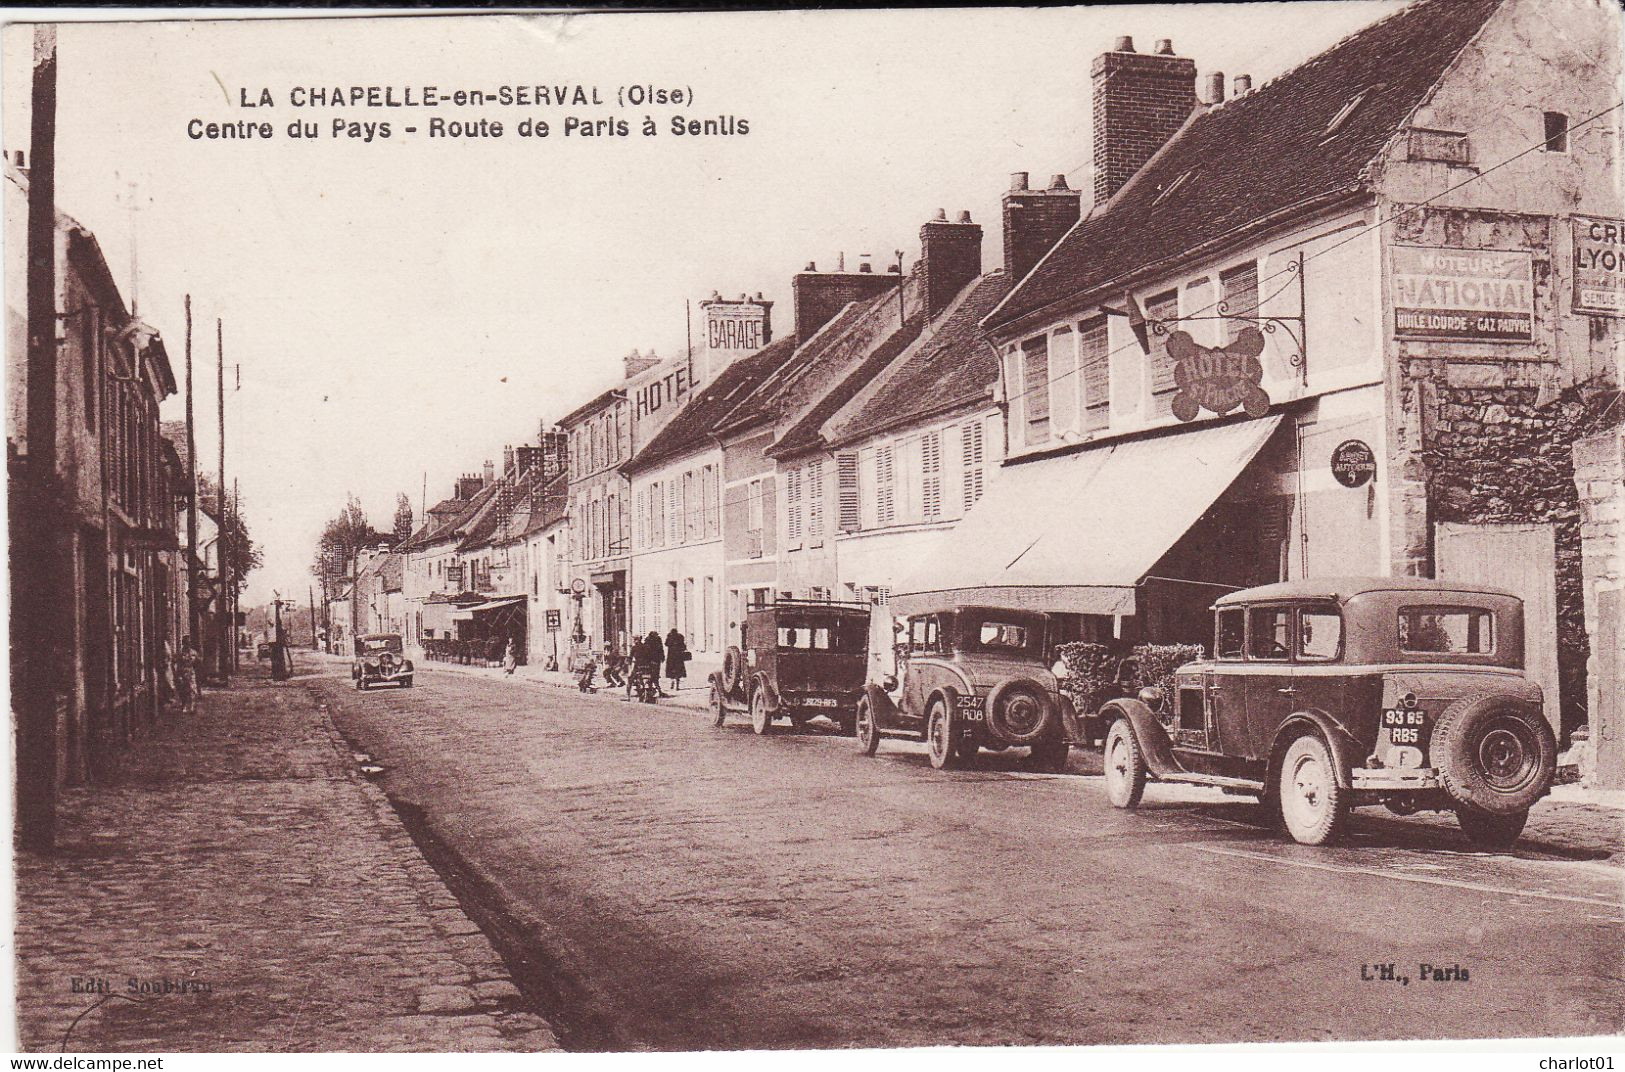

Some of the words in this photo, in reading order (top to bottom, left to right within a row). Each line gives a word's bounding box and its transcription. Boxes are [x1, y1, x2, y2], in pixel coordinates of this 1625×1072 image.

[1421, 255, 1505, 274] MOTEURS
[1396, 278, 1530, 309] NATIONAL
[1397, 314, 1425, 329] HUILE
[1428, 315, 1467, 331] LOURDE
[1477, 317, 1496, 332] GAZ
[708, 319, 762, 350] GARAGE
[1181, 350, 1255, 383] HOTEL
[636, 367, 700, 421] HOTEL
[957, 696, 984, 708] 2547
[1386, 710, 1404, 724] 93
[1392, 728, 1418, 743] RB5
[1400, 750, 1408, 766] F
